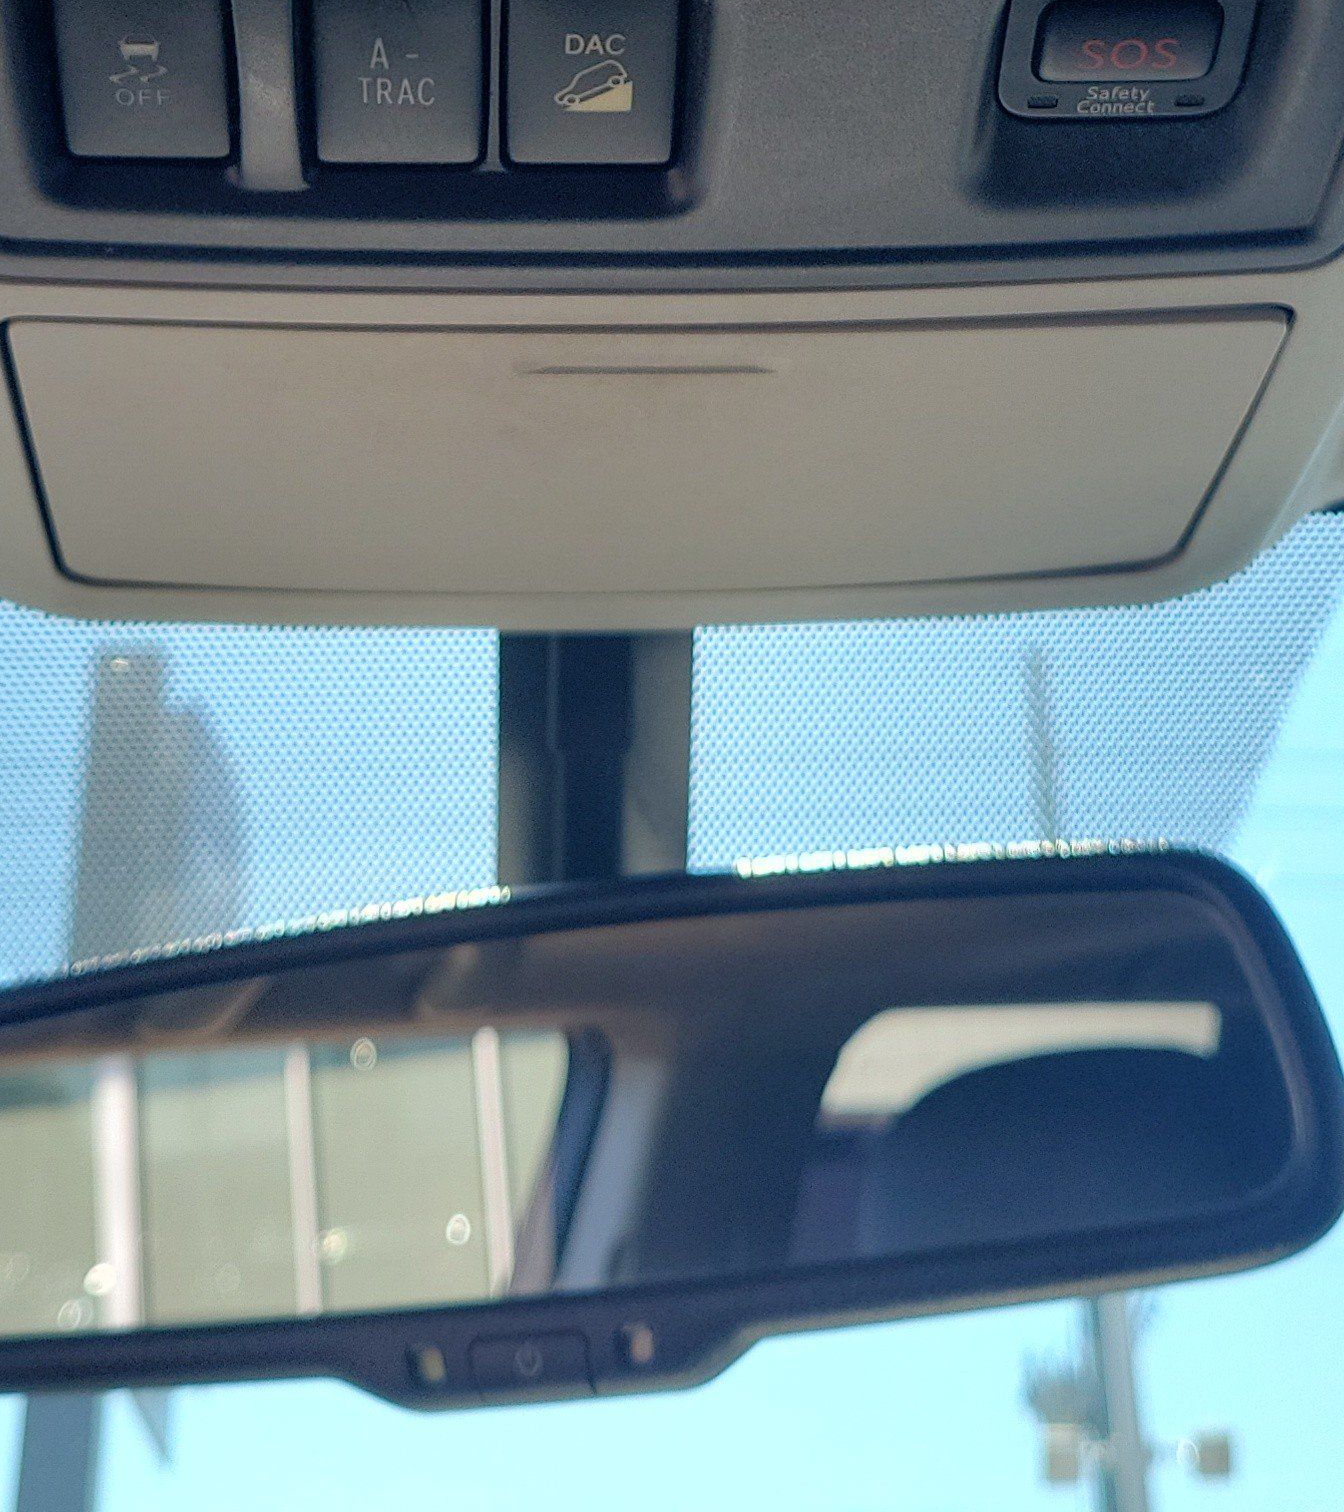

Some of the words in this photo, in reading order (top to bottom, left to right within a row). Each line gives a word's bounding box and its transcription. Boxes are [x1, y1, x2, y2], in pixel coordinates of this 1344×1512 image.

[564, 32, 627, 56] DAC
[1074, 36, 1181, 71] SOS
[115, 88, 170, 106] OFF
[358, 76, 436, 107] TRAC
[1086, 86, 1151, 101] Safety
[1076, 99, 1156, 115] Connect
